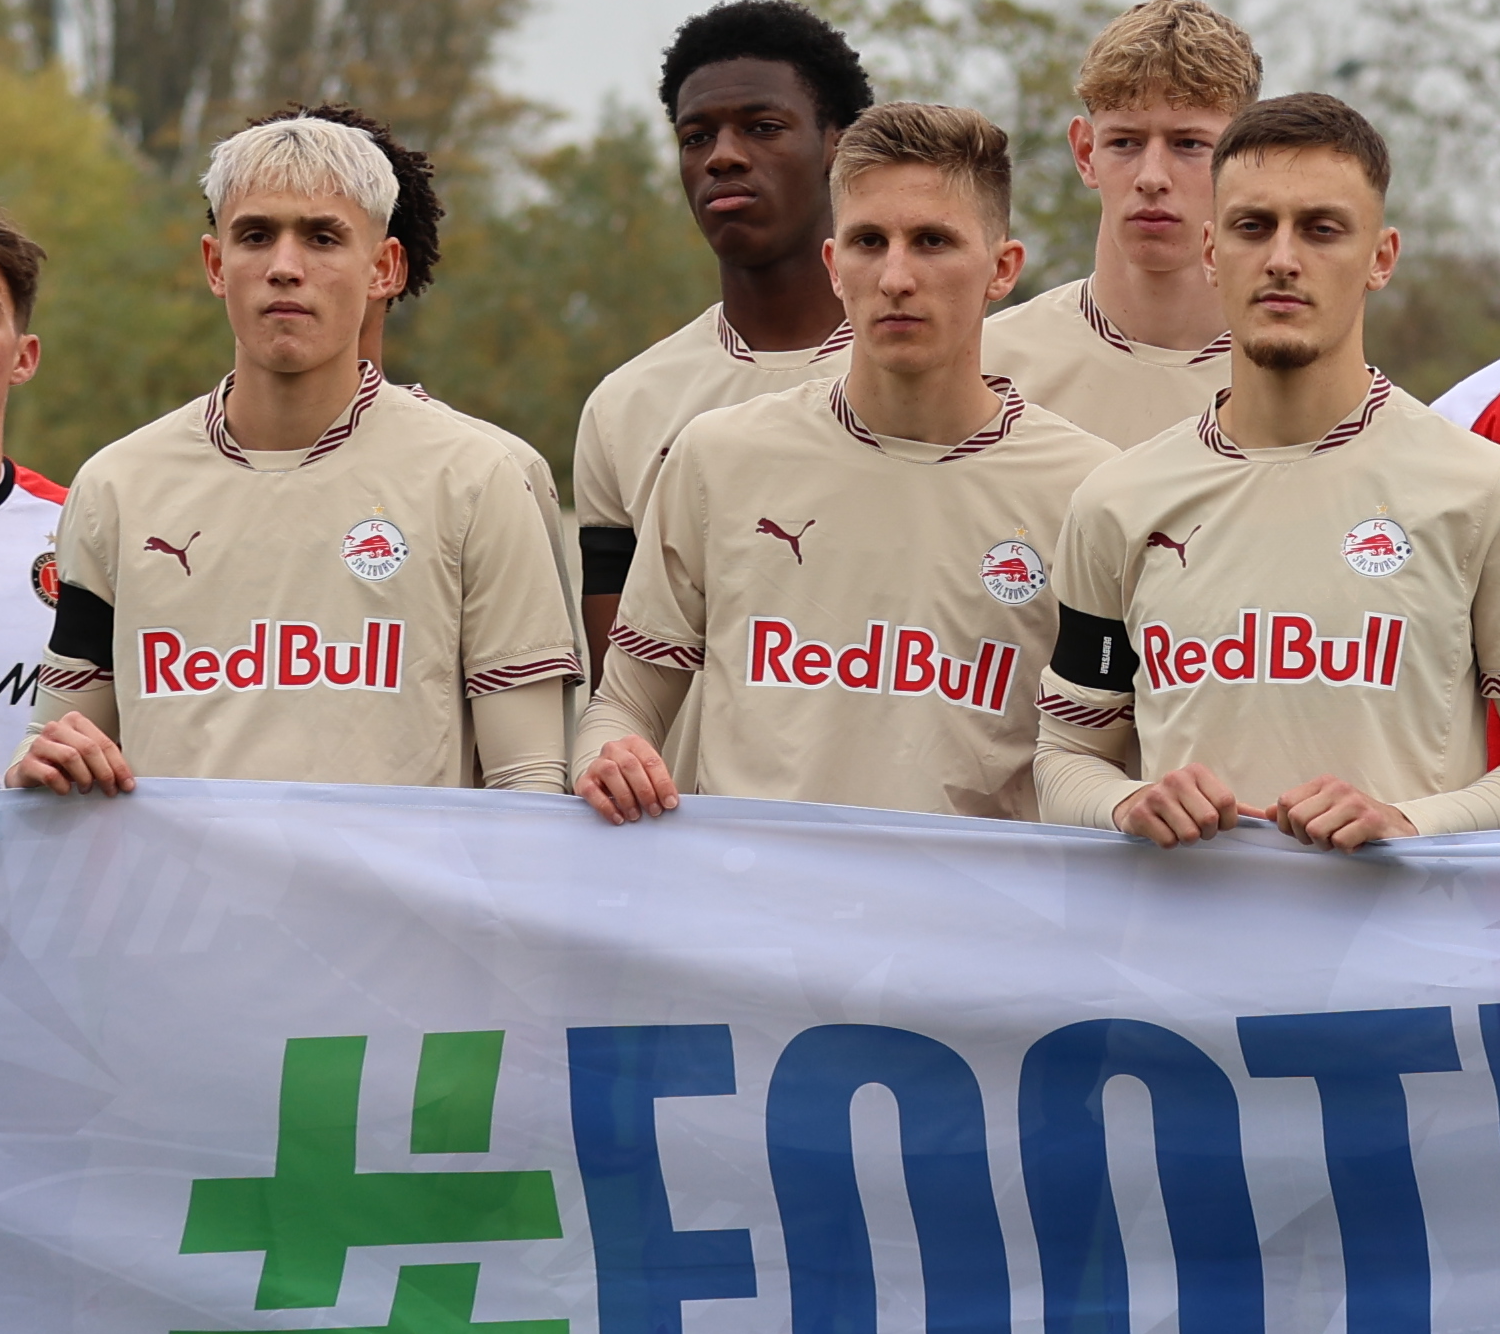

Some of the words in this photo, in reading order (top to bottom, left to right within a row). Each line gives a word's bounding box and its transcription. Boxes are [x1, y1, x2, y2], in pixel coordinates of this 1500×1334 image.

[371, 523, 383, 532] FC
[1374, 522, 1386, 532] FC
[1010, 545, 1023, 556] FC
[351, 557, 394, 577] SALZBURG
[1352, 555, 1397, 573] SALZBURG
[988, 578, 1030, 600] SALZBURG
